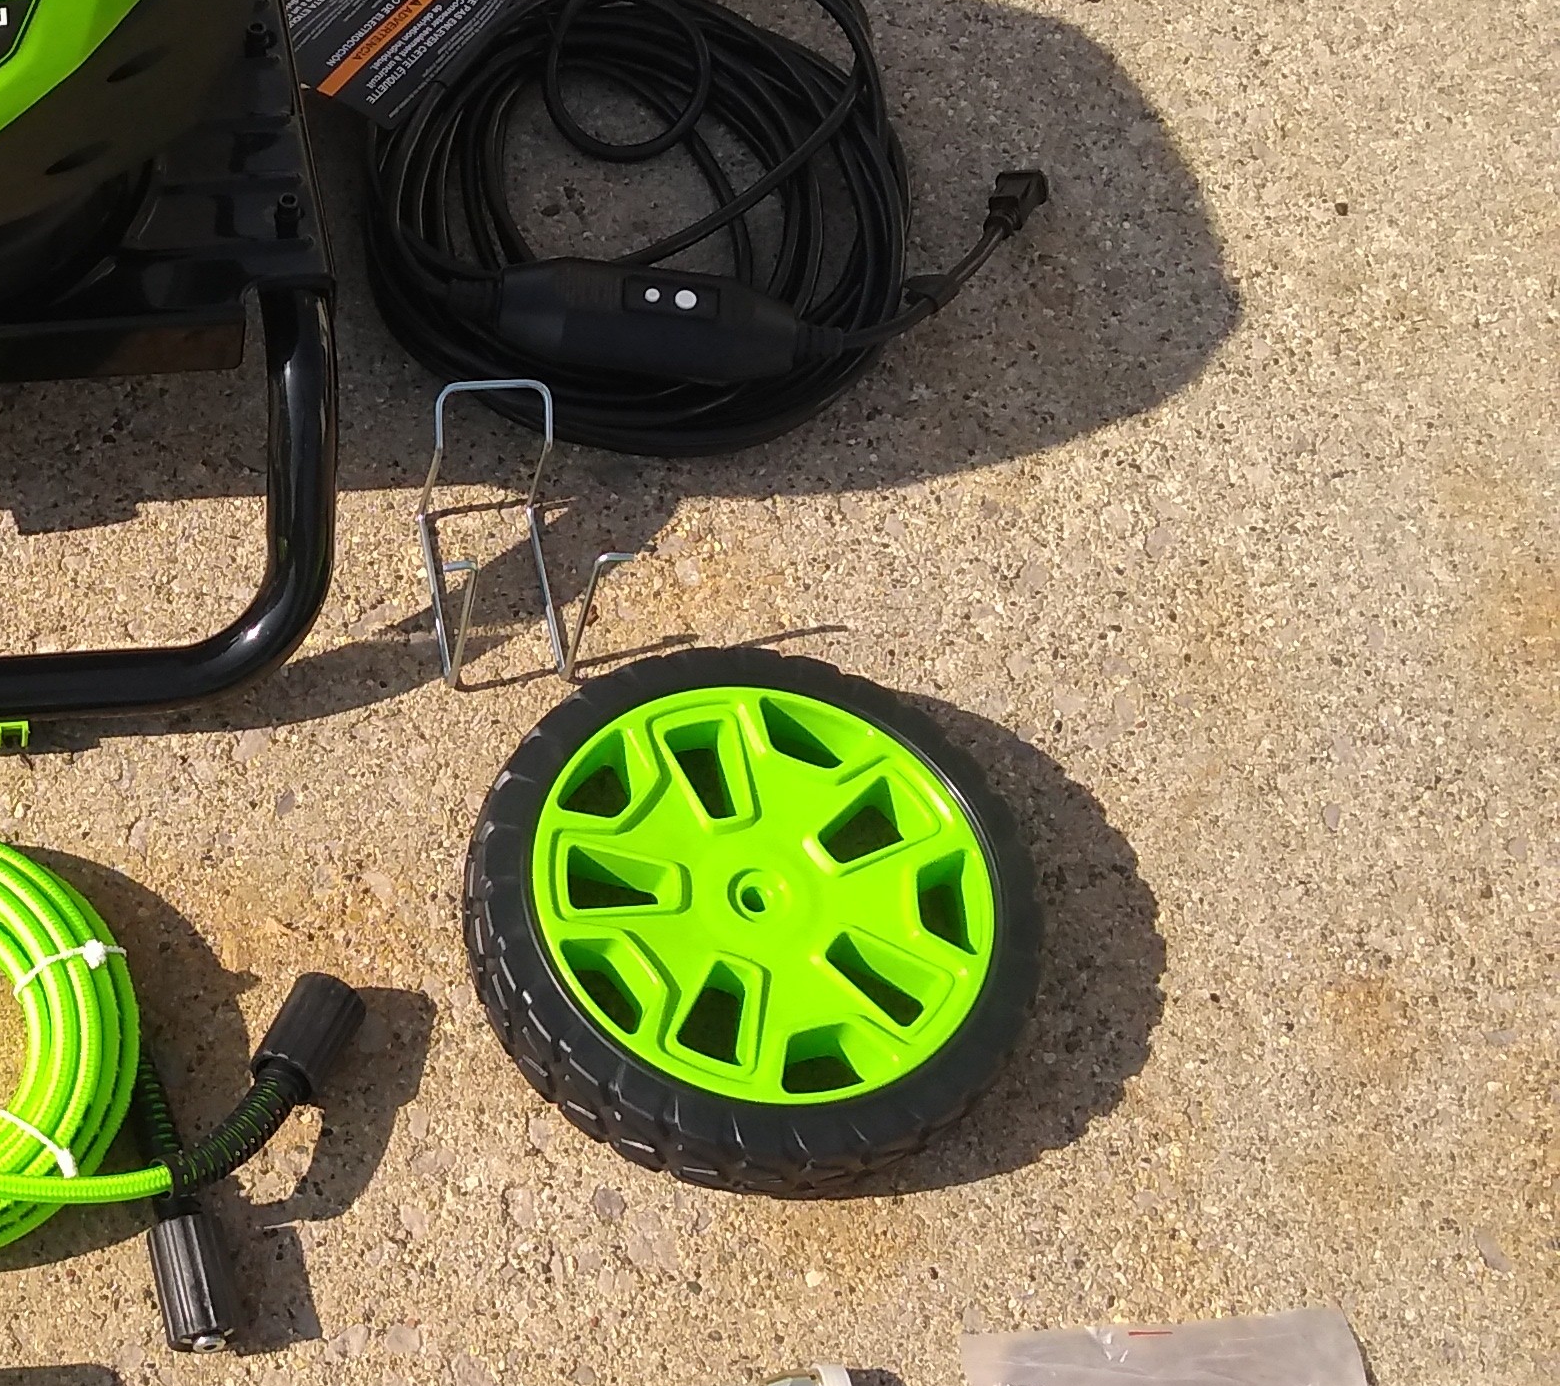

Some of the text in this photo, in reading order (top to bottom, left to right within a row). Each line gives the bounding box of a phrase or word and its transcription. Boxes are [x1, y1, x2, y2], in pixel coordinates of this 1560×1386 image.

[380, 2, 395, 15] DE
[325, 11, 385, 67] ELECTROCUCIÓN
[352, 5, 413, 63] ADVERTENCIA
[401, 43, 427, 68] CETTE
